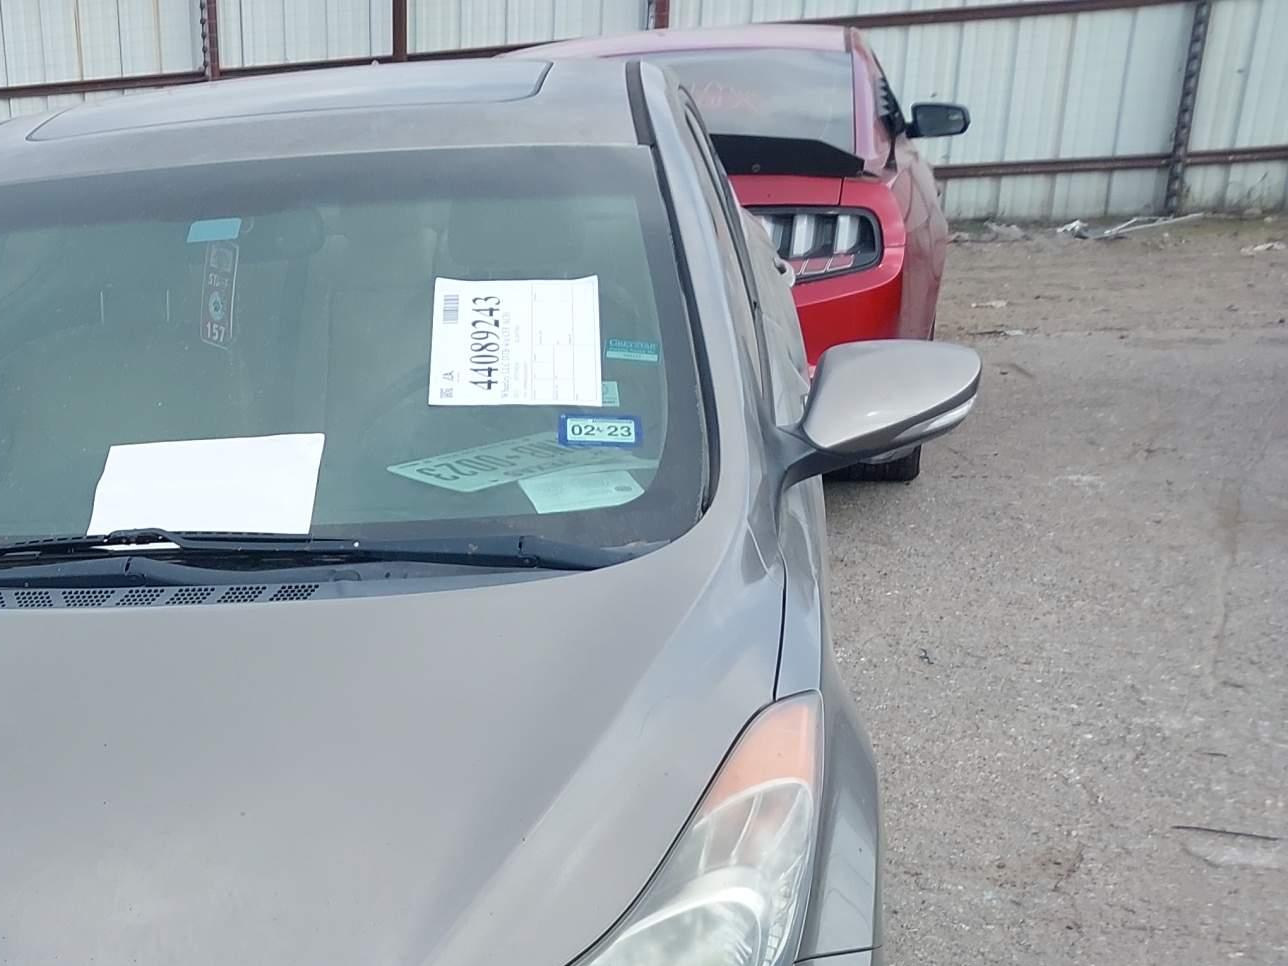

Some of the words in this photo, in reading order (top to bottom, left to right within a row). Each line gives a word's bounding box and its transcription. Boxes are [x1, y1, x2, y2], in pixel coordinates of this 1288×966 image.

[206, 320, 226, 343] 157
[469, 295, 501, 391] 44089243
[571, 424, 596, 436] 02
[607, 425, 632, 437] 23
